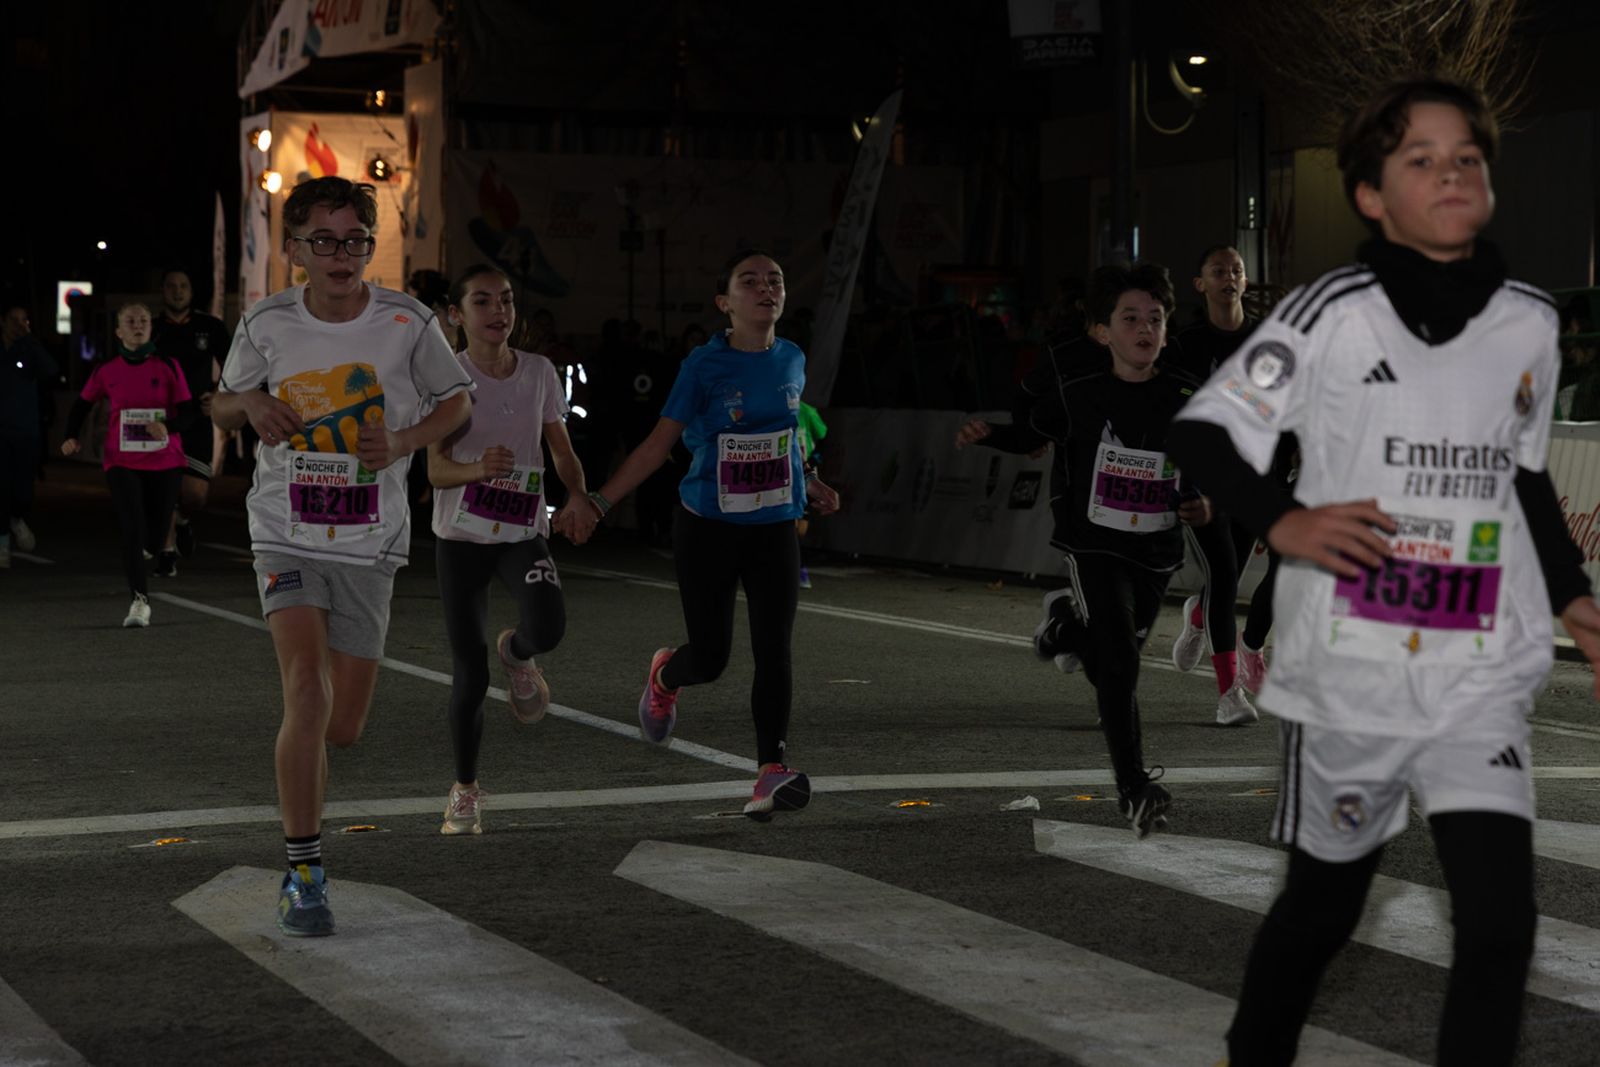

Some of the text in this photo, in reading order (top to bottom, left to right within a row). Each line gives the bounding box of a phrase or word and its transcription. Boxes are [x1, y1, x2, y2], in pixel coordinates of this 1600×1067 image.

[727, 452, 744, 460] SAN
[1116, 456, 1158, 469] NOCHE DE
[1384, 435, 1513, 472] Emirates
[296, 473, 314, 484] SAN
[305, 463, 349, 474] NOCHE DE
[730, 460, 784, 485] 14974
[1104, 464, 1123, 476] SAN
[1403, 471, 1498, 500] FLY BETTER
[299, 485, 368, 514] 15210
[473, 483, 535, 517] 14951
[1363, 557, 1483, 614] 15311
